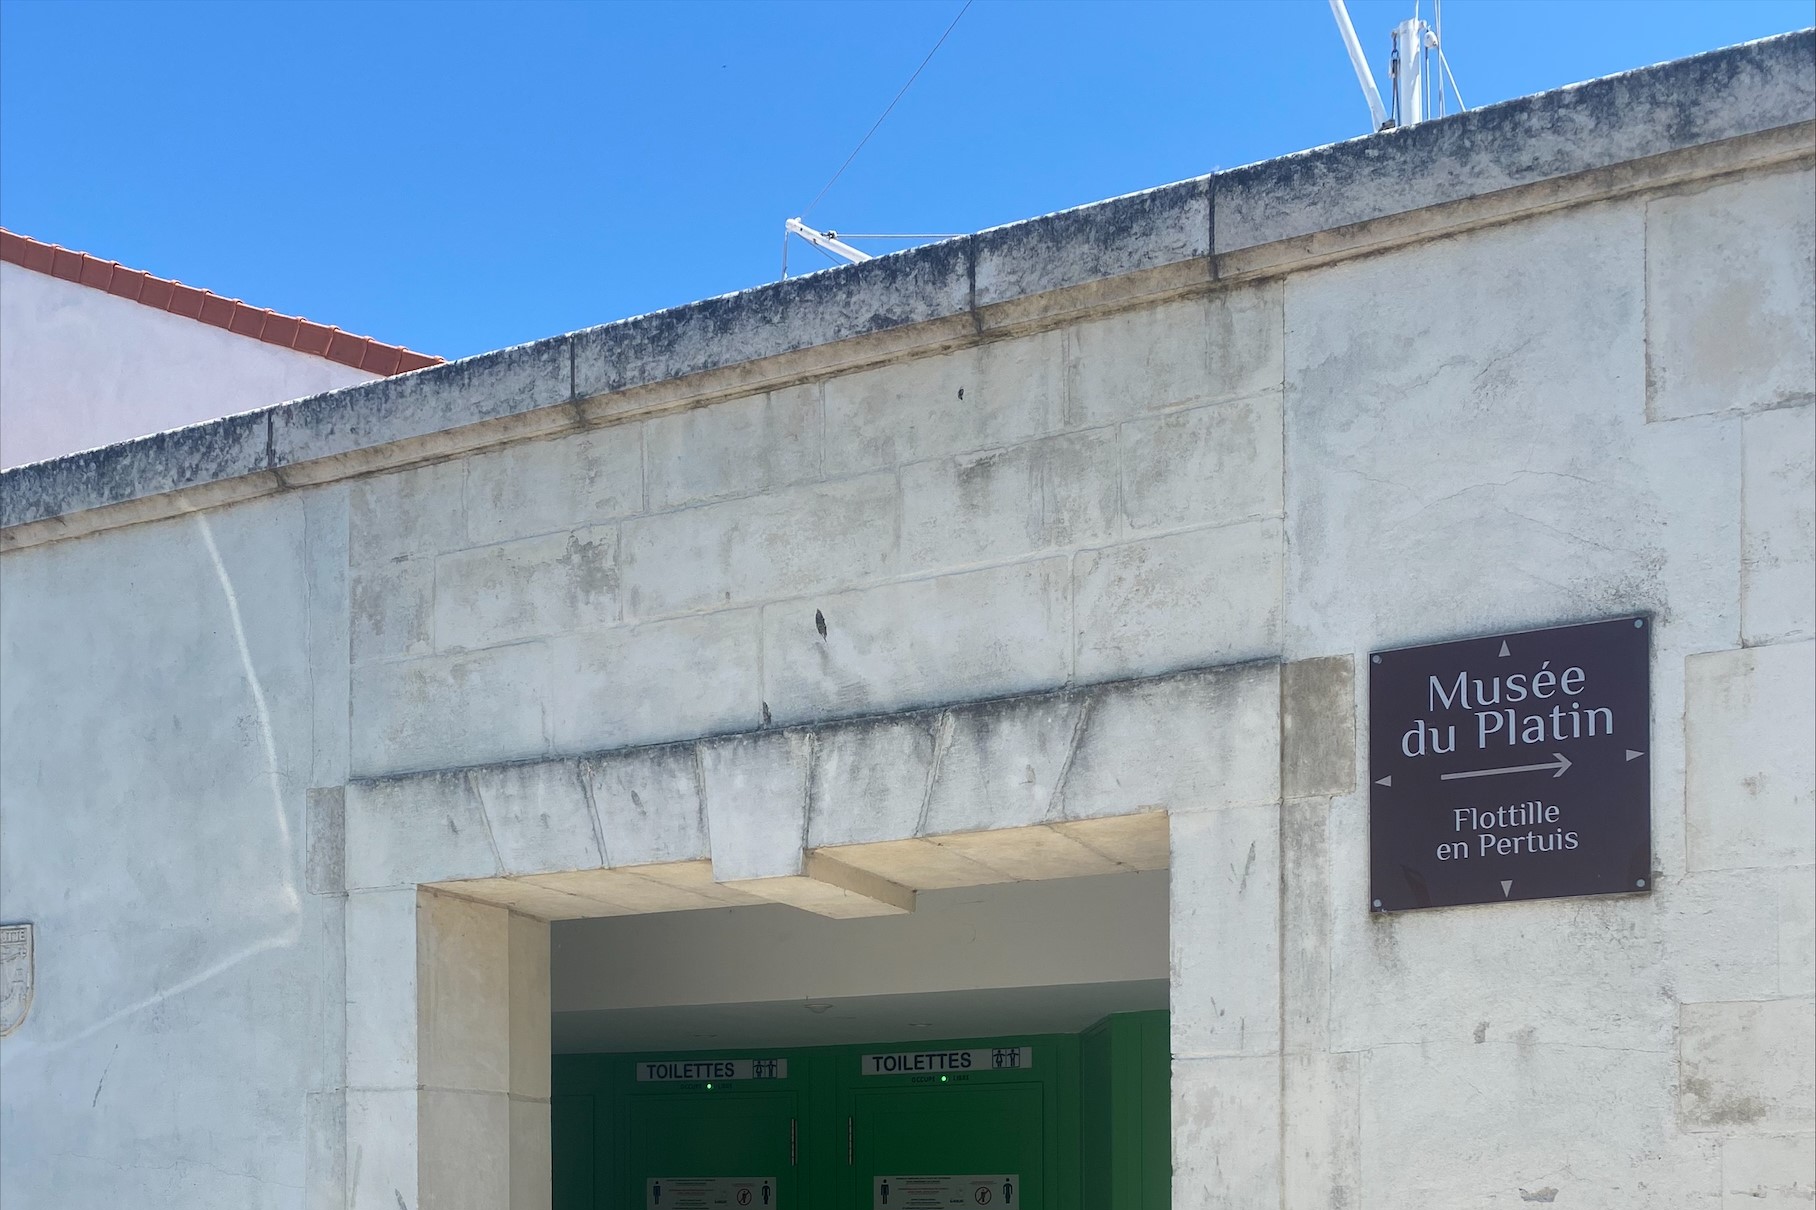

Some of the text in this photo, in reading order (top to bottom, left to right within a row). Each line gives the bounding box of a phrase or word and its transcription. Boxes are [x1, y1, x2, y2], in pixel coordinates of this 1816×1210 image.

[1429, 661, 1586, 712] Musée
[1401, 702, 1613, 757] du Platin
[1453, 800, 1560, 831] Flottille
[1436, 828, 1579, 860] en Pertuis
[646, 1062, 735, 1079] TOILETTES
[872, 1052, 972, 1072] TOILETTES
